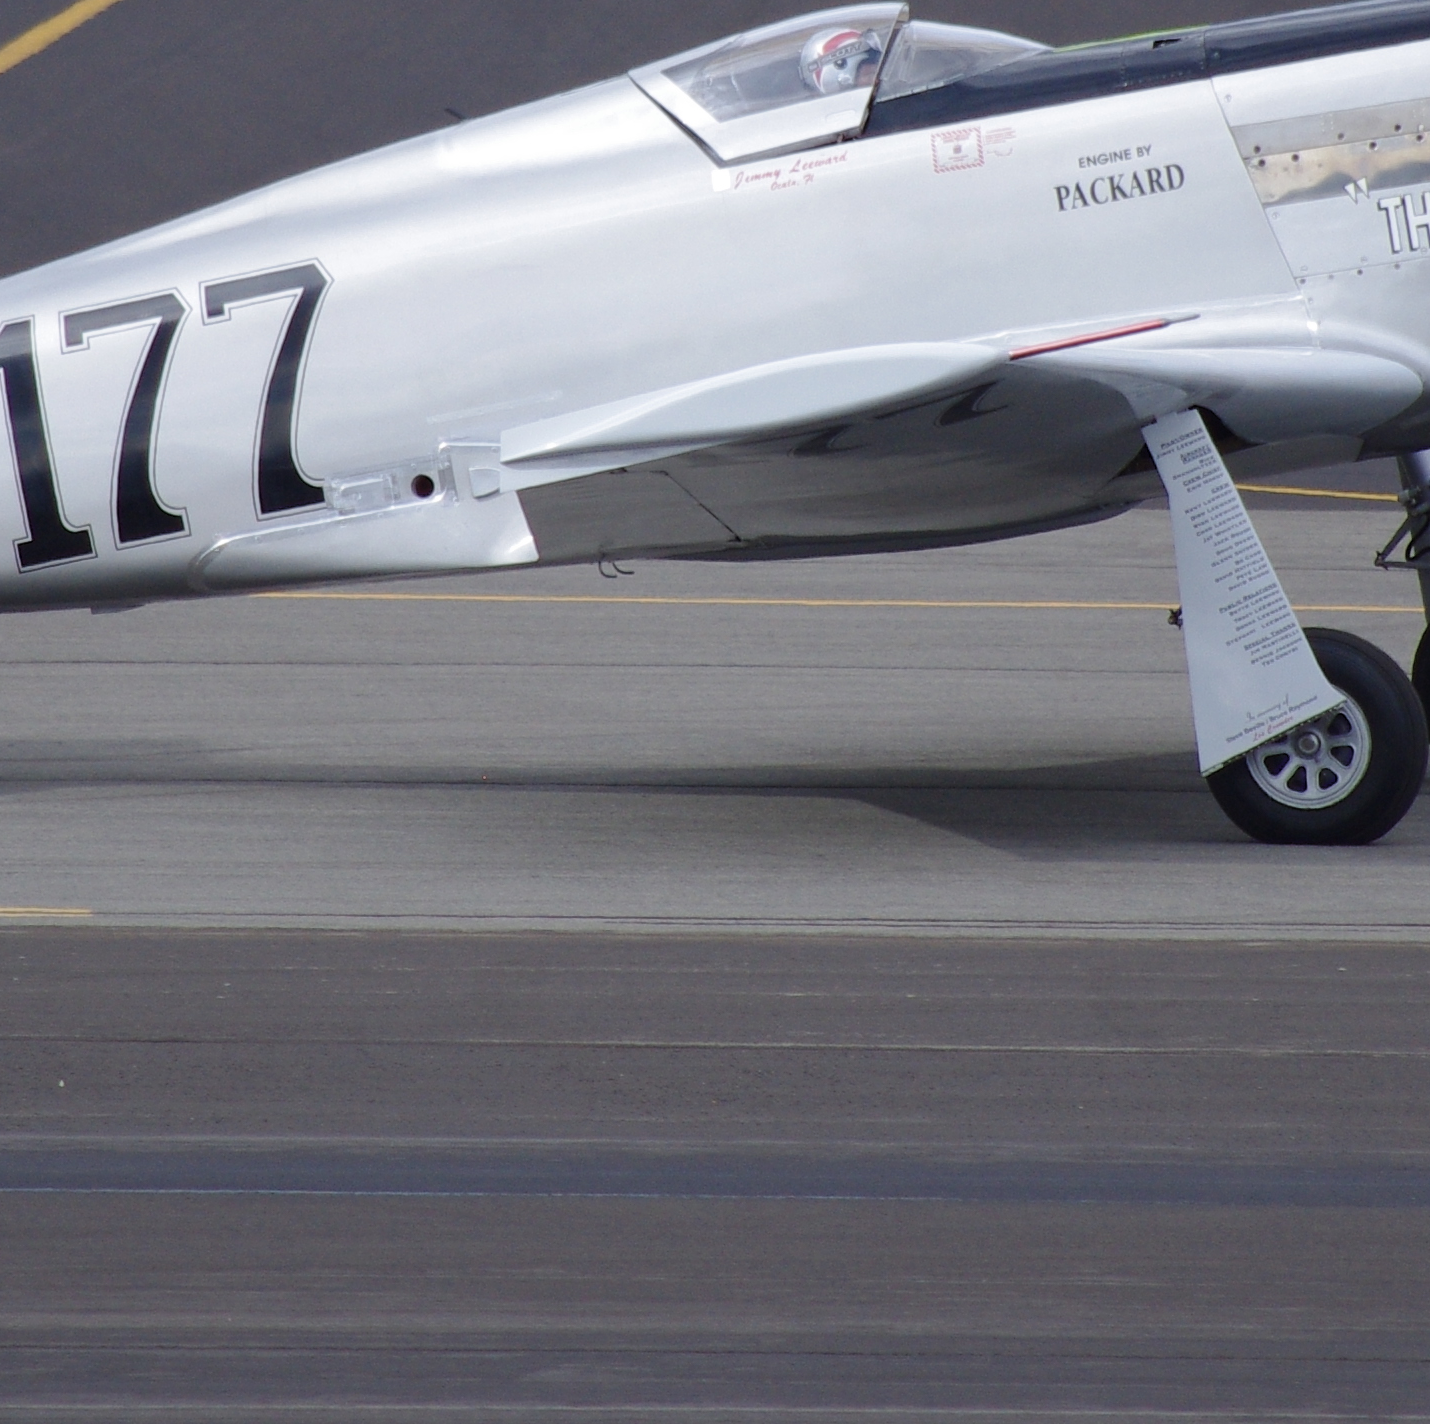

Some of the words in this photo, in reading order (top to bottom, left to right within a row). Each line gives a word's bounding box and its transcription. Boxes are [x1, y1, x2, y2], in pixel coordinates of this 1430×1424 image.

[789, 150, 849, 178] Leeward
[1078, 149, 1132, 169] ENGINE
[1135, 144, 1152, 161] BY
[1053, 163, 1186, 213] PACKARD
